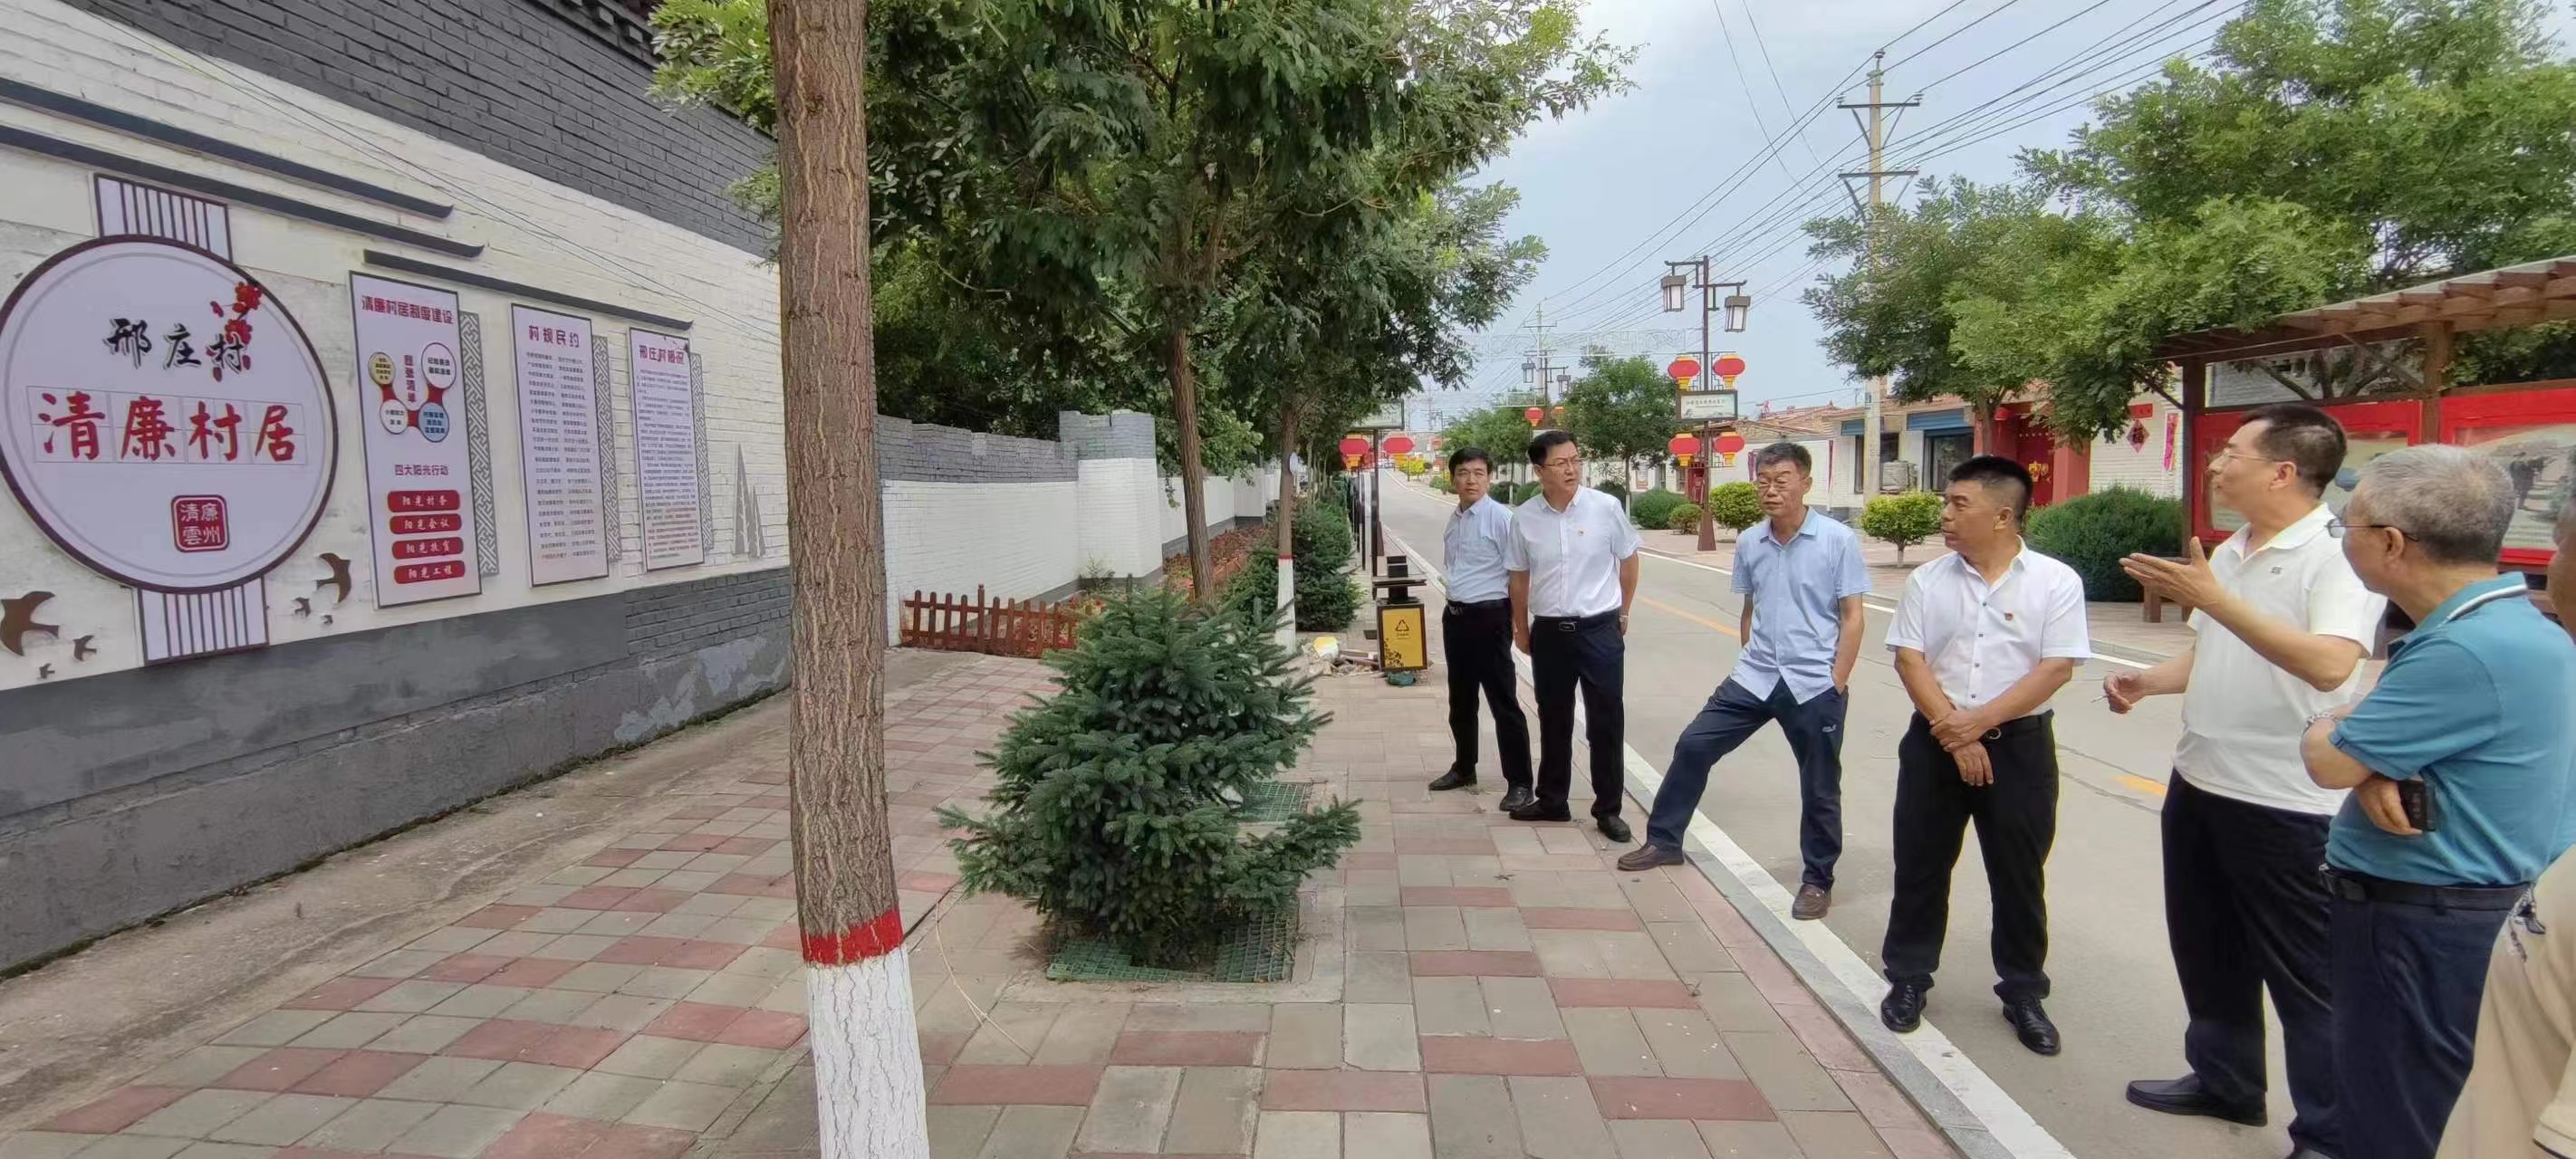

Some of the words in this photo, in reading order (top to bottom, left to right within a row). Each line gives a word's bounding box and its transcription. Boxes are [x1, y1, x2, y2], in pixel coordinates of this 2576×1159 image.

[361, 295, 453, 324] 清廉村居制度建设
[103, 317, 245, 372] 邢庄村
[528, 324, 580, 349] 村规民约
[38, 391, 296, 462] 清廉村居
[394, 464, 449, 476] 四大阳光行动
